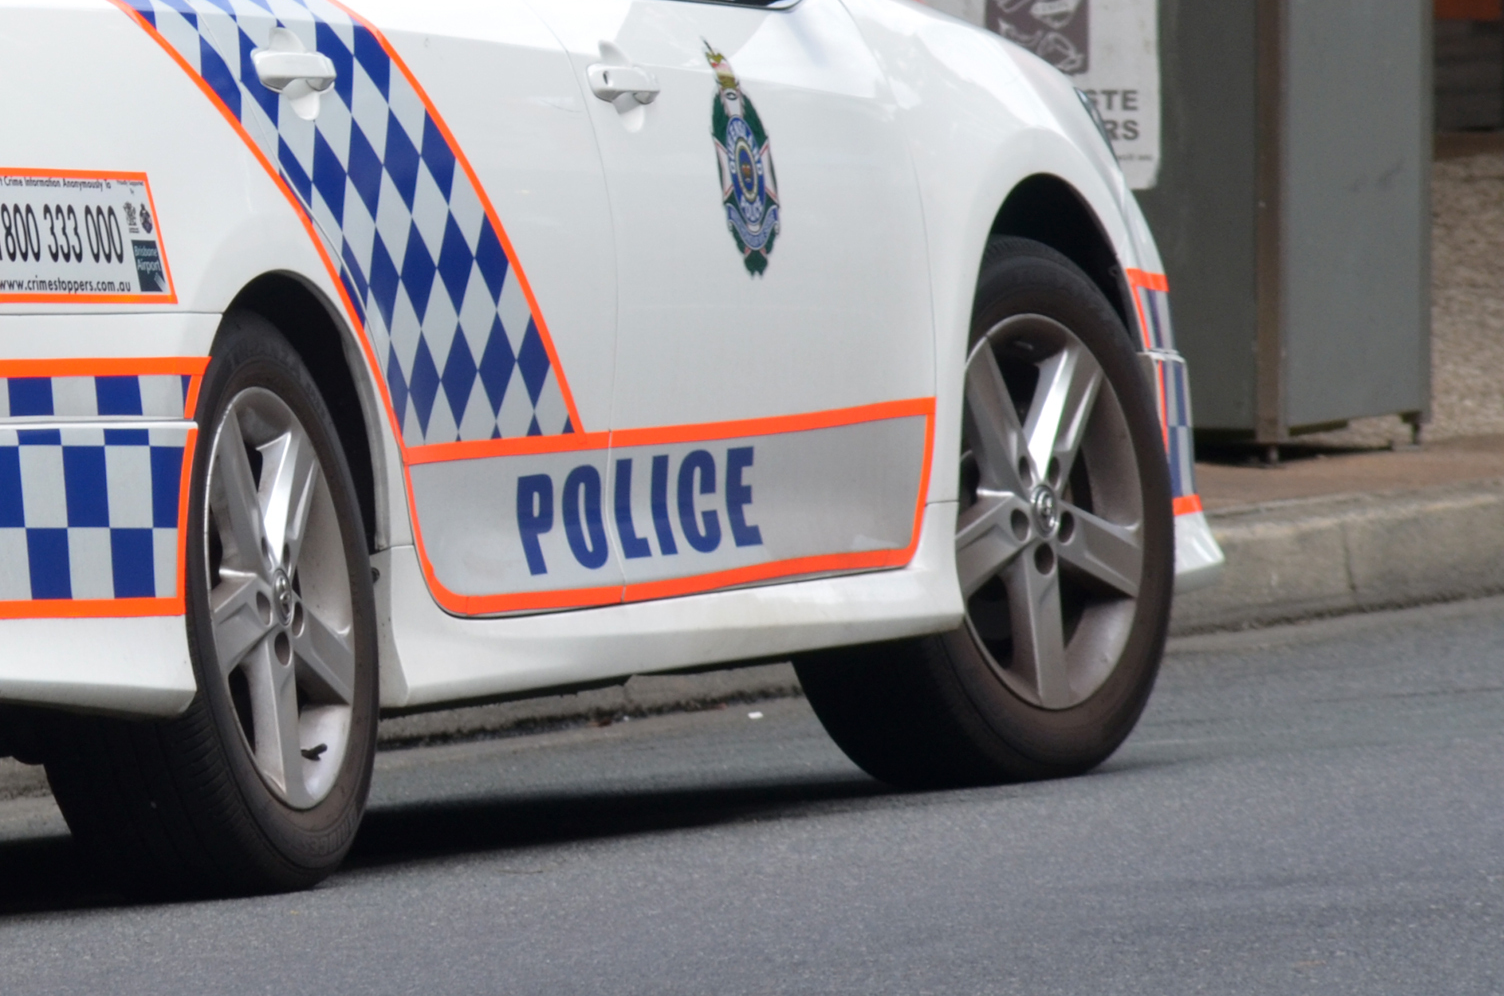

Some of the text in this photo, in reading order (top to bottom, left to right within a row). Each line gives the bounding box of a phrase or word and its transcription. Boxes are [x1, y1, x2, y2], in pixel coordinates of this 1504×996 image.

[4, 176, 23, 187] Crime
[24, 177, 61, 188] Information
[62, 178, 103, 192] Anonymously
[104, 179, 112, 189] To
[43, 203, 83, 263] 333
[84, 205, 124, 264] 000
[133, 245, 158, 257] Brisbane
[136, 258, 161, 276] Airport
[516, 446, 763, 576] POLICE
